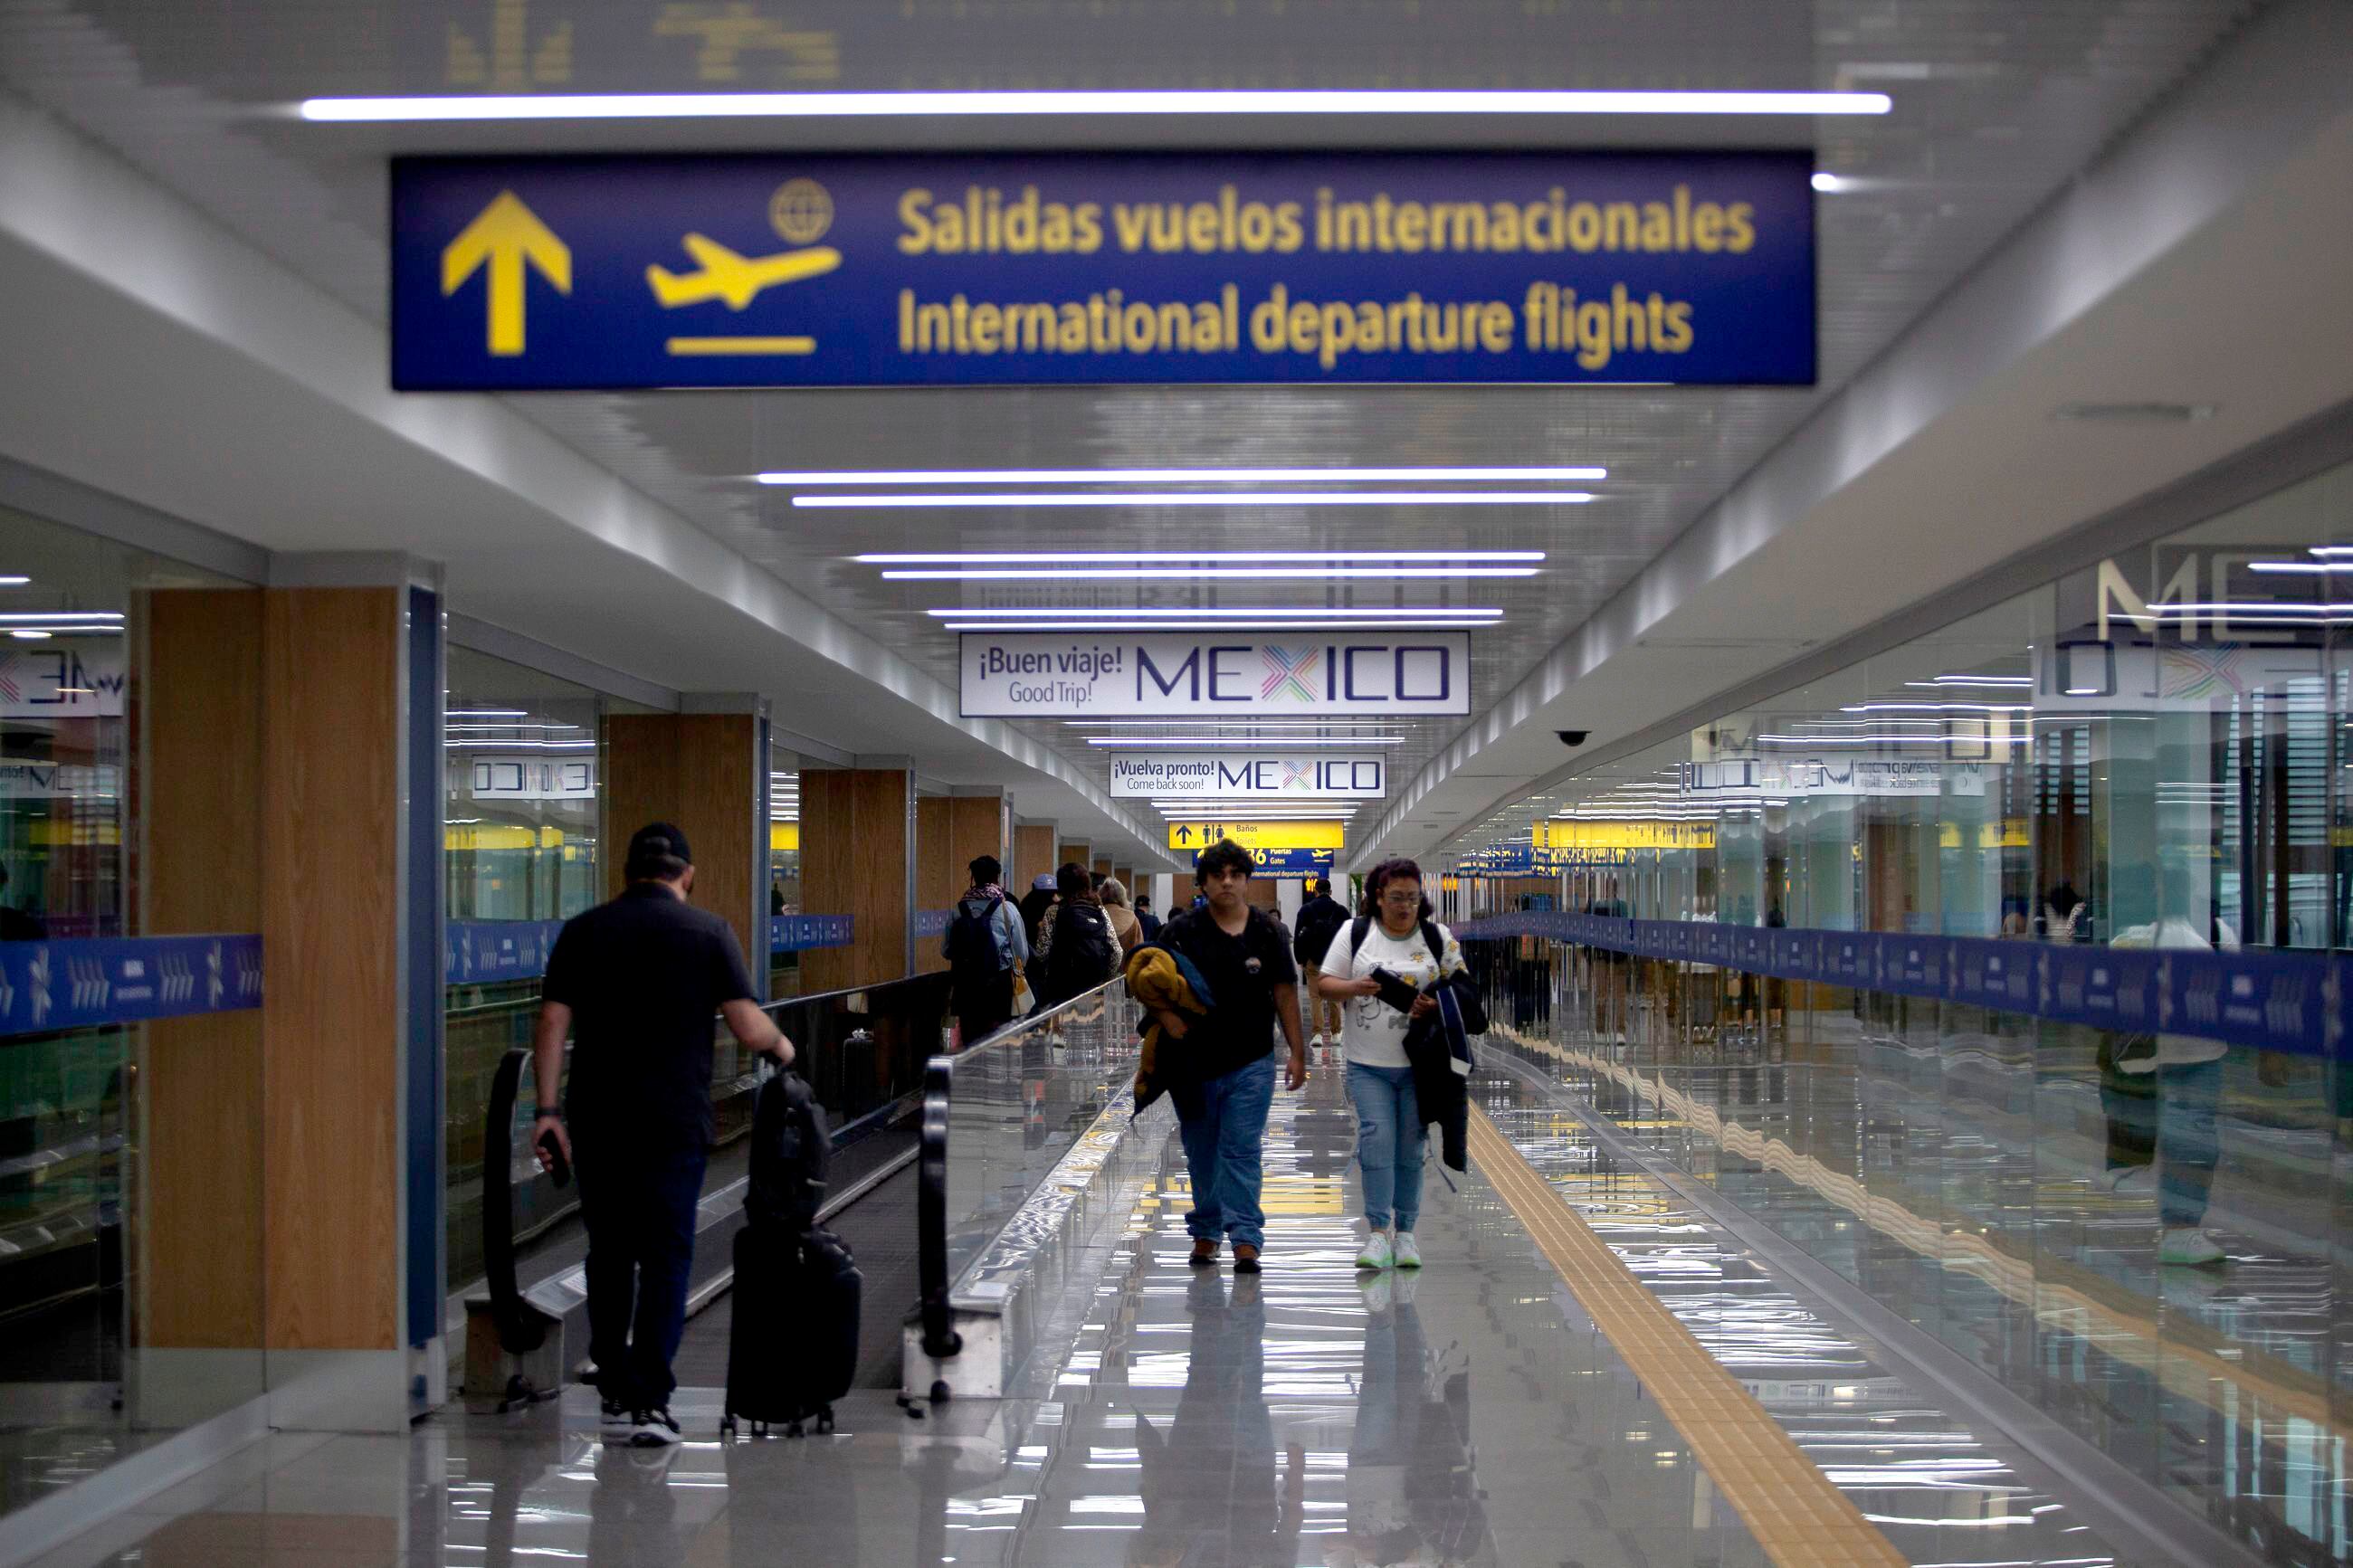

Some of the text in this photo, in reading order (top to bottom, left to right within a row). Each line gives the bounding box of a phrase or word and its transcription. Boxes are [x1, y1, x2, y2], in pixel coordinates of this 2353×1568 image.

[897, 184, 1757, 255] Salidas vuelos internacionales
[898, 280, 1694, 372] International departure flights
[980, 645, 1122, 681] ¡Buen viaje!
[1136, 645, 1450, 703] MEXICO
[1009, 680, 1092, 708] Good Trip!
[1114, 759, 1215, 780] ¡Vuelva pronto!
[1127, 777, 1205, 790] Come back soon!
[1217, 760, 1381, 791] MEXICO
[1236, 824, 1258, 832] Baños
[1236, 837, 1257, 845] Toilets
[1270, 857, 1286, 865] Gates
